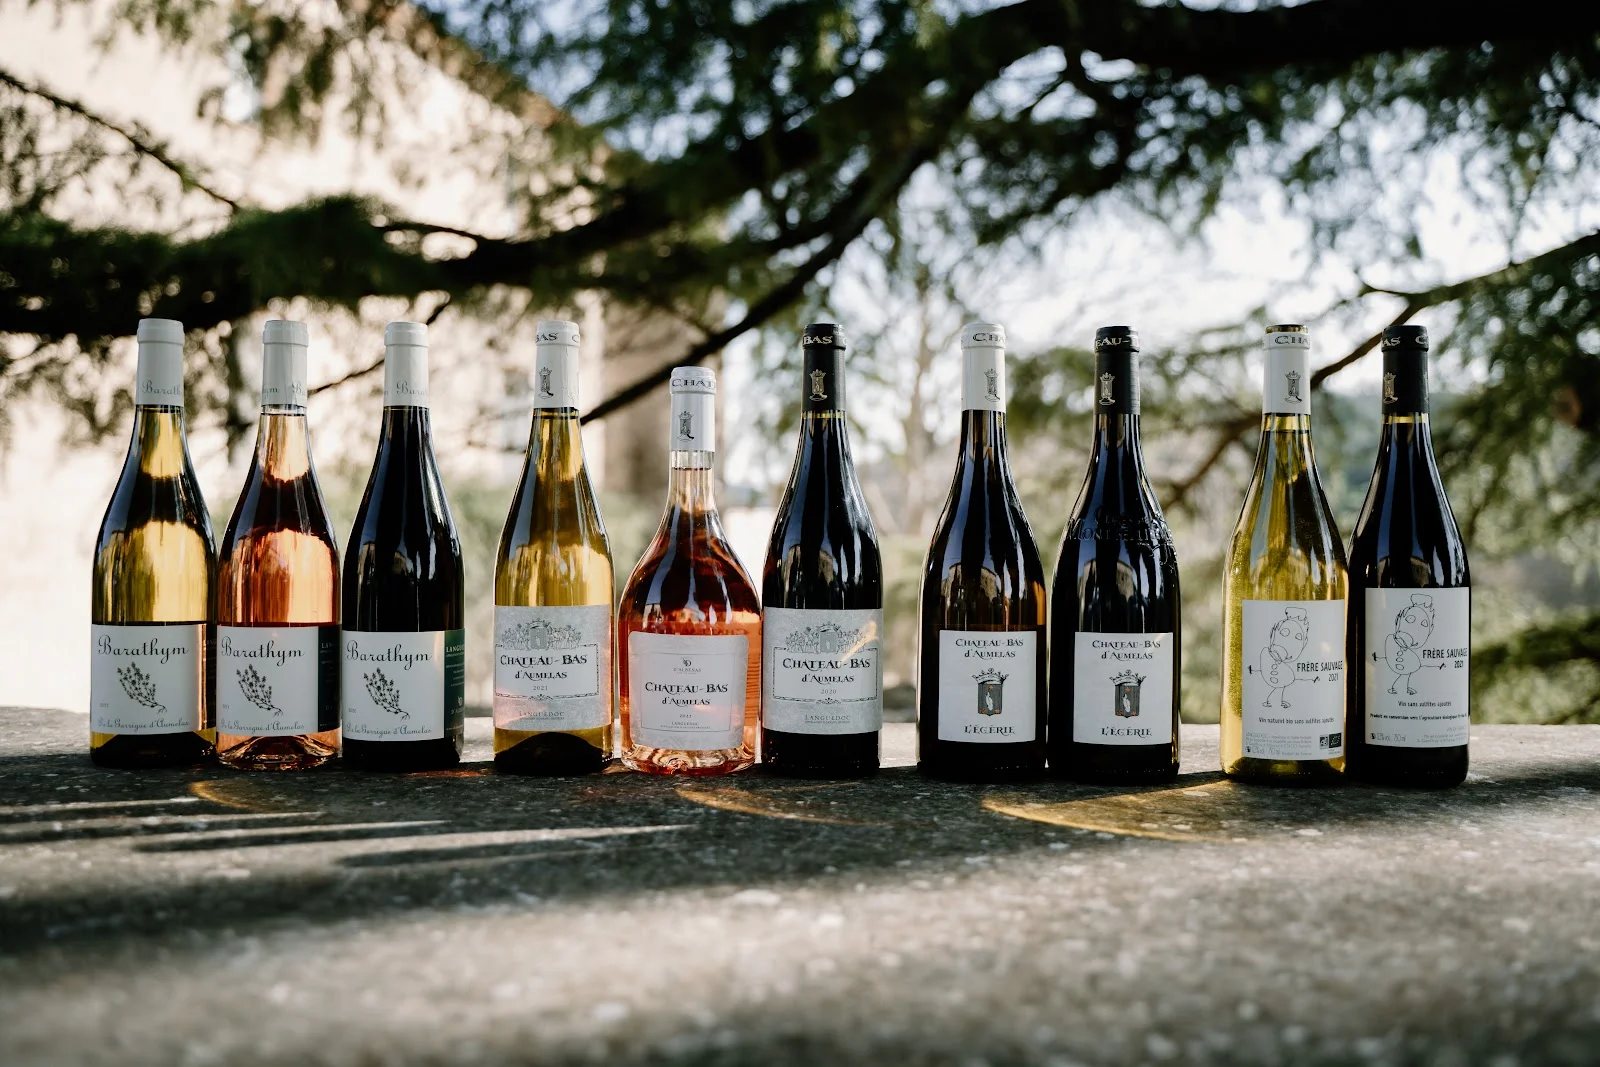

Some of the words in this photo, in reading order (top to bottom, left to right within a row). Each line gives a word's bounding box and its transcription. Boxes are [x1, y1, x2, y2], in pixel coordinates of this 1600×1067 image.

[803, 335, 834, 345] BAS
[98, 634, 189, 664] Barathym
[221, 636, 306, 667] Barathym
[346, 640, 432, 670] Barathym
[1422, 648, 1445, 659] FRÈRE
[1446, 647, 1468, 659] SAUVAGE
[1296, 661, 1319, 672] FRÈRE
[1320, 660, 1343, 672] SAUVAGE
[1328, 673, 1339, 681] 2021
